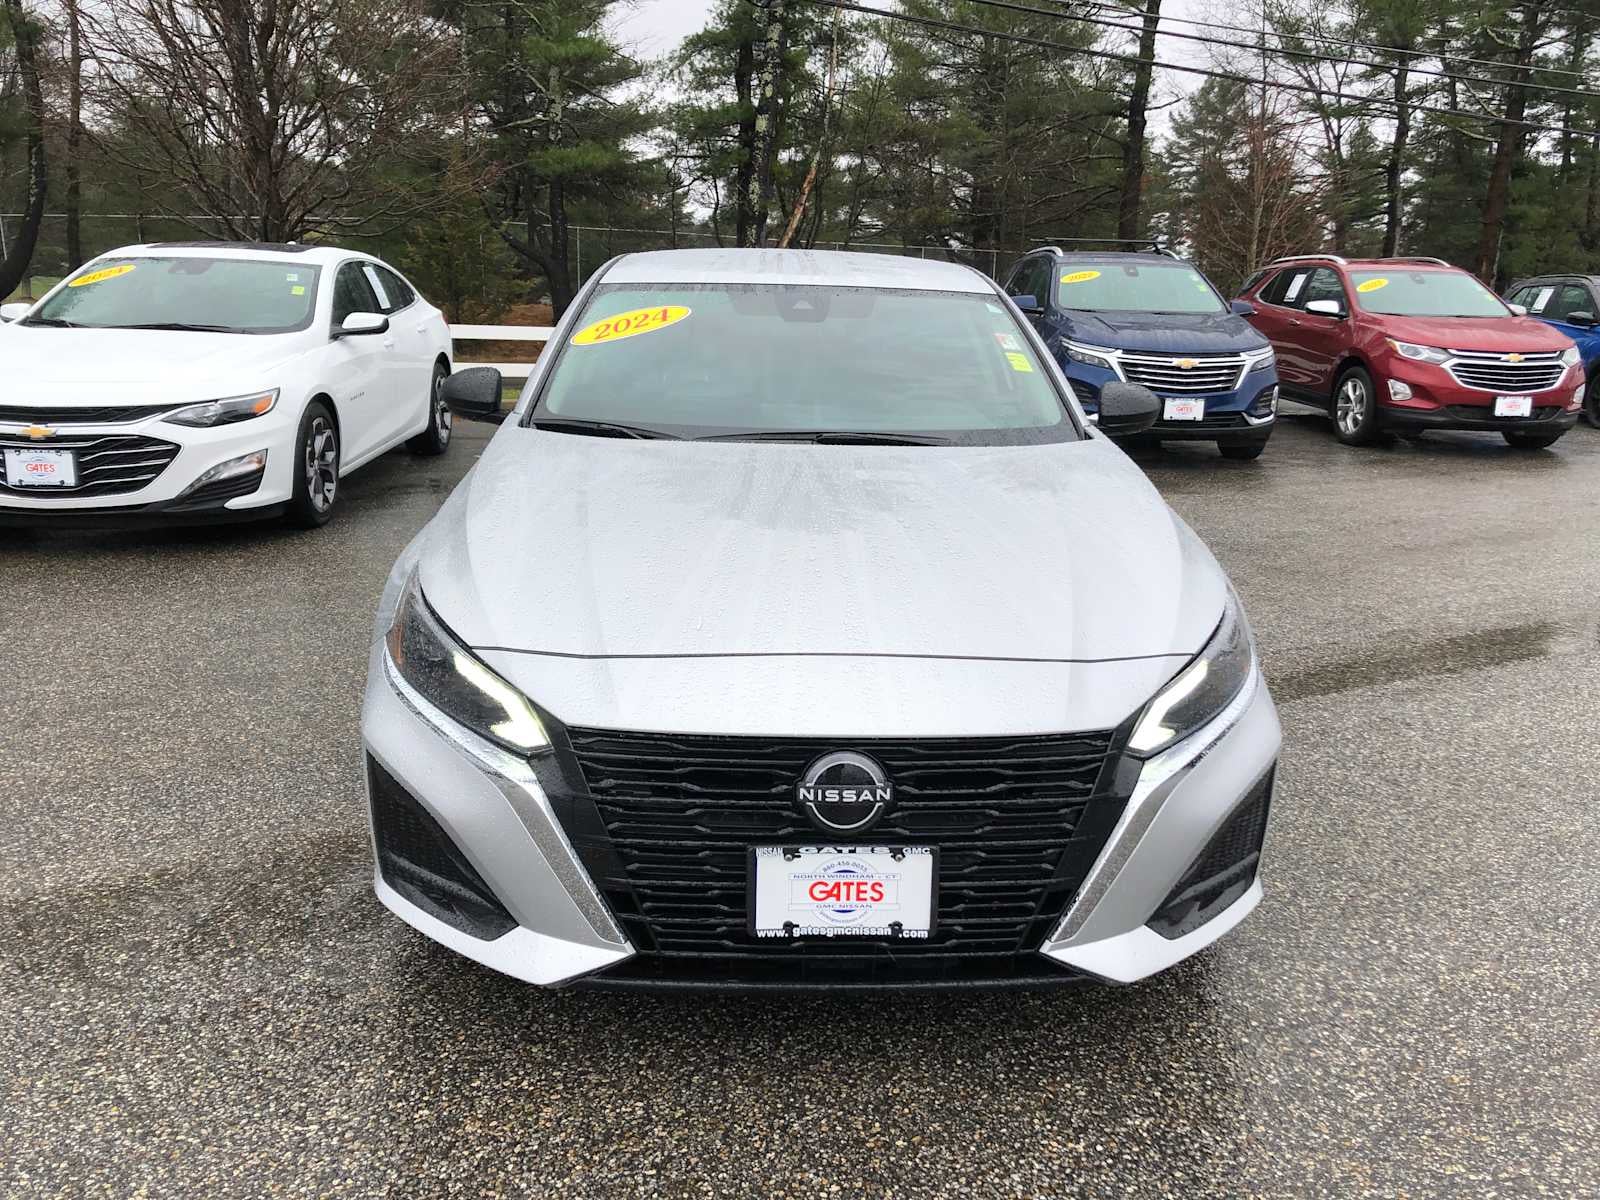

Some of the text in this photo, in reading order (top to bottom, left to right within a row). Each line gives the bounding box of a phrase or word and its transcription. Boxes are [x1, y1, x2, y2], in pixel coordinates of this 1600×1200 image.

[594, 308, 669, 340] 2024
[25, 463, 56, 473] GATES
[799, 787, 891, 802] NISSAN
[756, 846, 930, 856] NISSAN GATES GMC
[808, 881, 885, 902] GATES
[756, 929, 789, 938] www.
[792, 926, 892, 937] gatesgmcnissan
